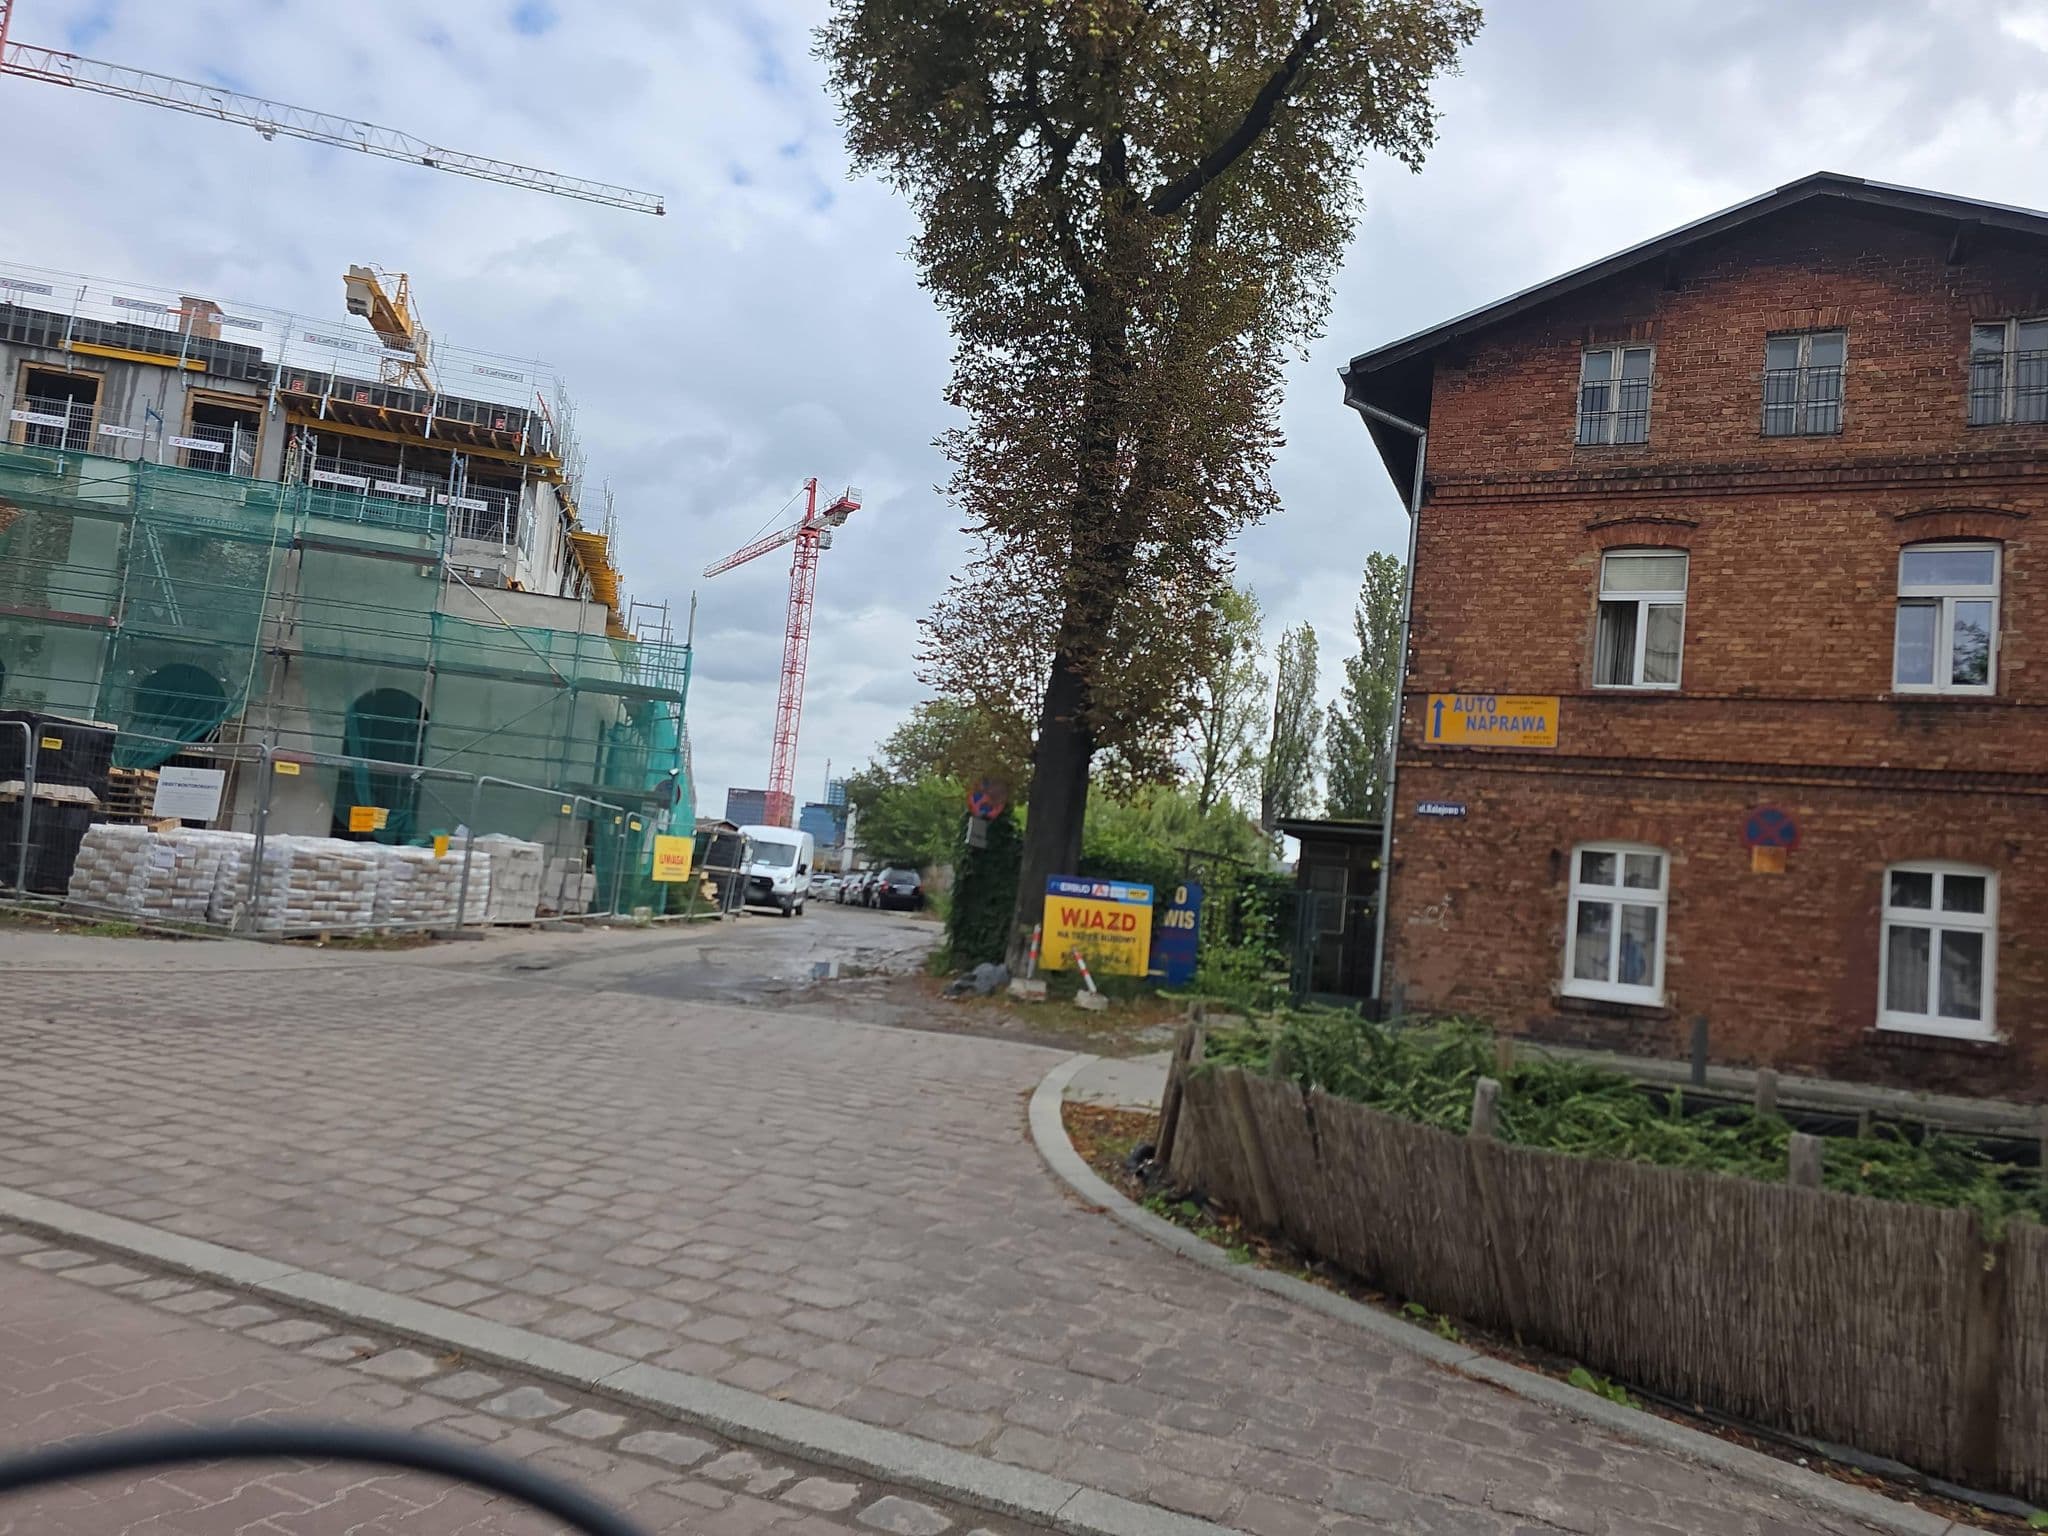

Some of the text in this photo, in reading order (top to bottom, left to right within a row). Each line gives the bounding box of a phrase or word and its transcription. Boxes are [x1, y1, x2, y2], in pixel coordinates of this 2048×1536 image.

[318, 336, 352, 348] Lafretz
[451, 497, 483, 508] Lfrentz
[1454, 697, 1496, 712] AUTO
[1467, 716, 1546, 732] NAPRAWA
[1061, 908, 1136, 931] WJAZD
